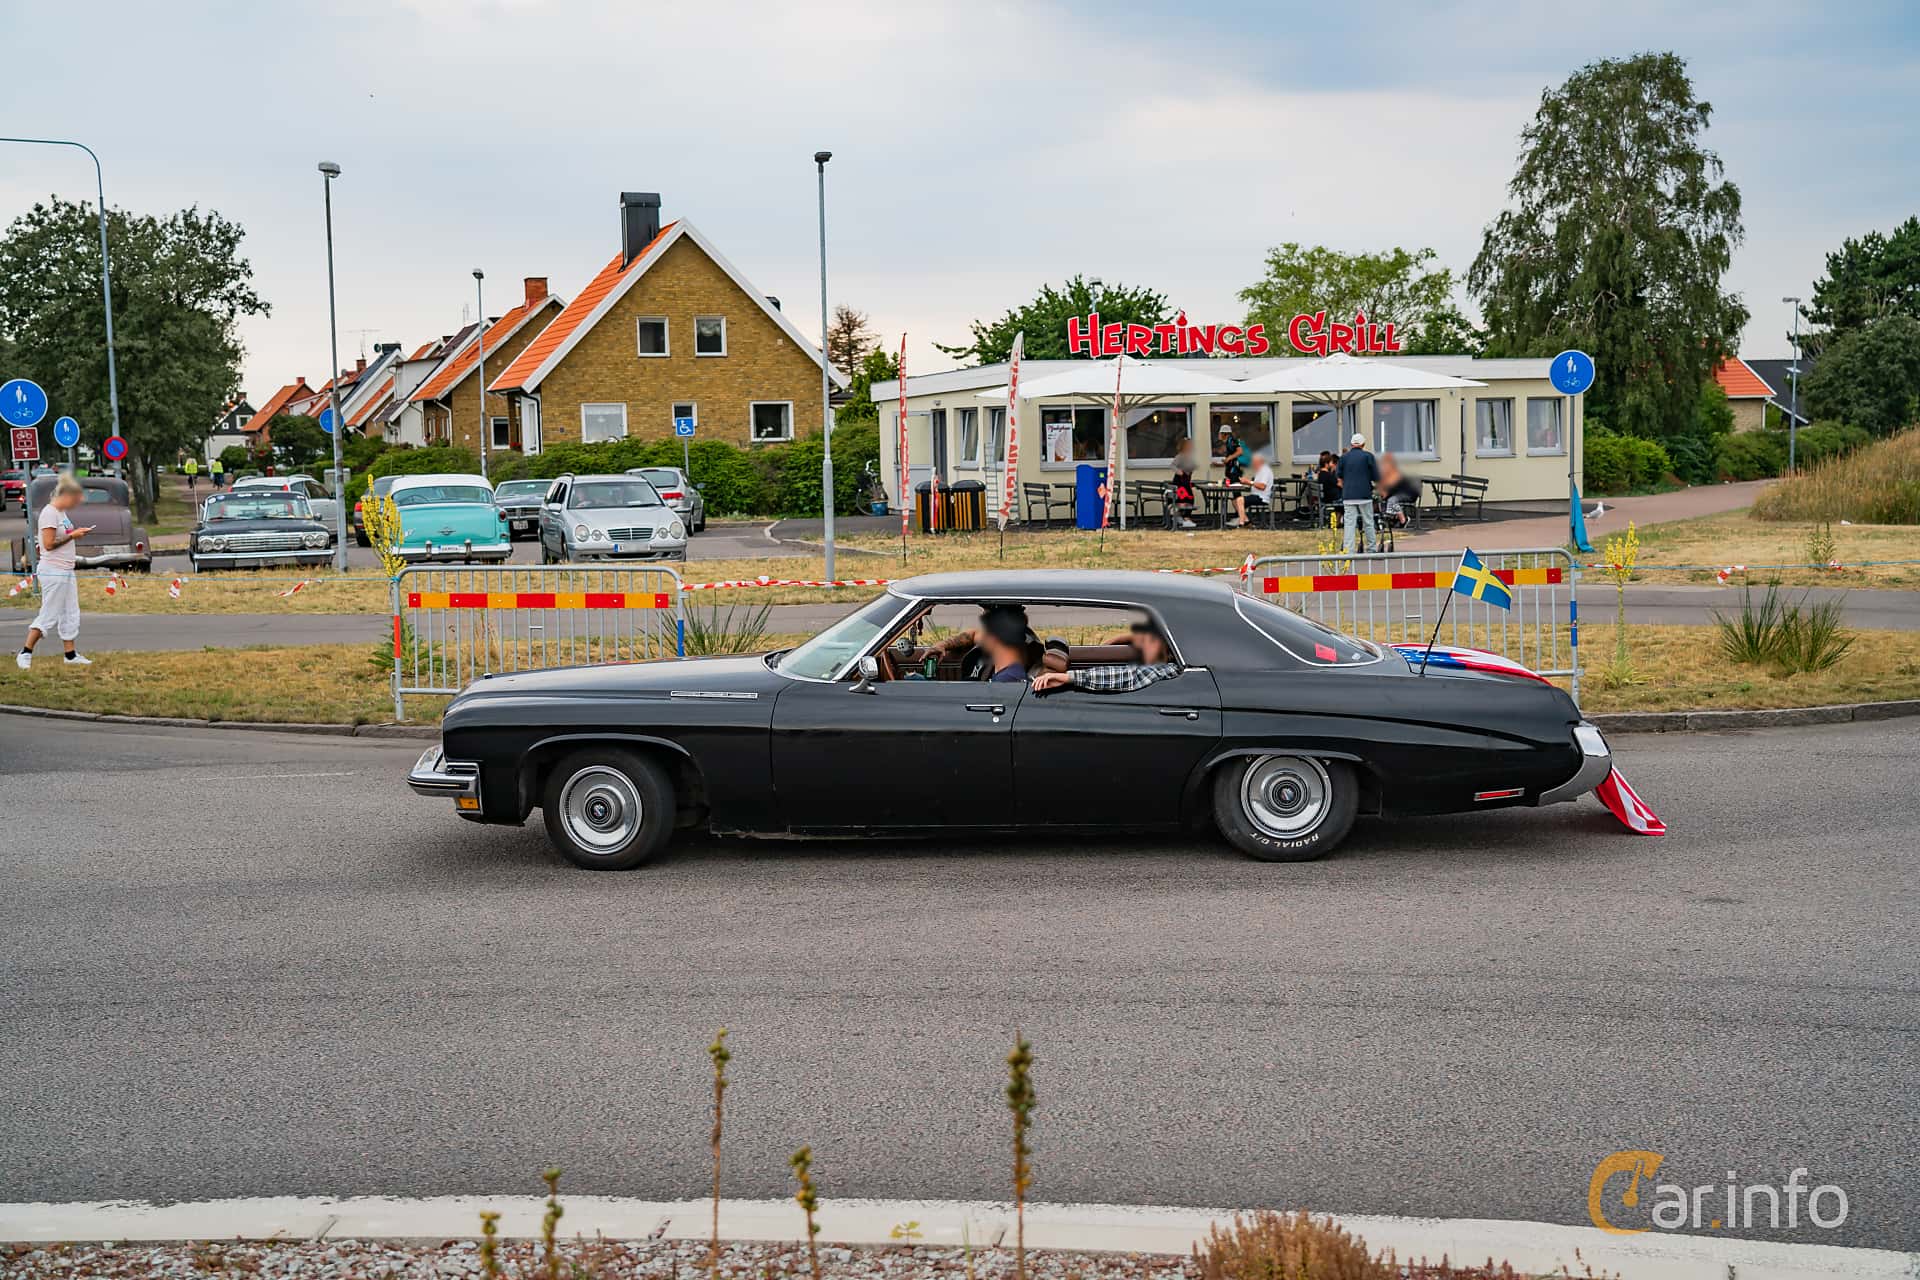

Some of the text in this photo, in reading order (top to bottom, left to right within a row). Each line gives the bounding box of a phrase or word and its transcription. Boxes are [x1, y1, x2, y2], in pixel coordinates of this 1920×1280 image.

[1068, 309, 1401, 358] HERTINGS GRILL
[1274, 833, 1320, 848] RADIAL
